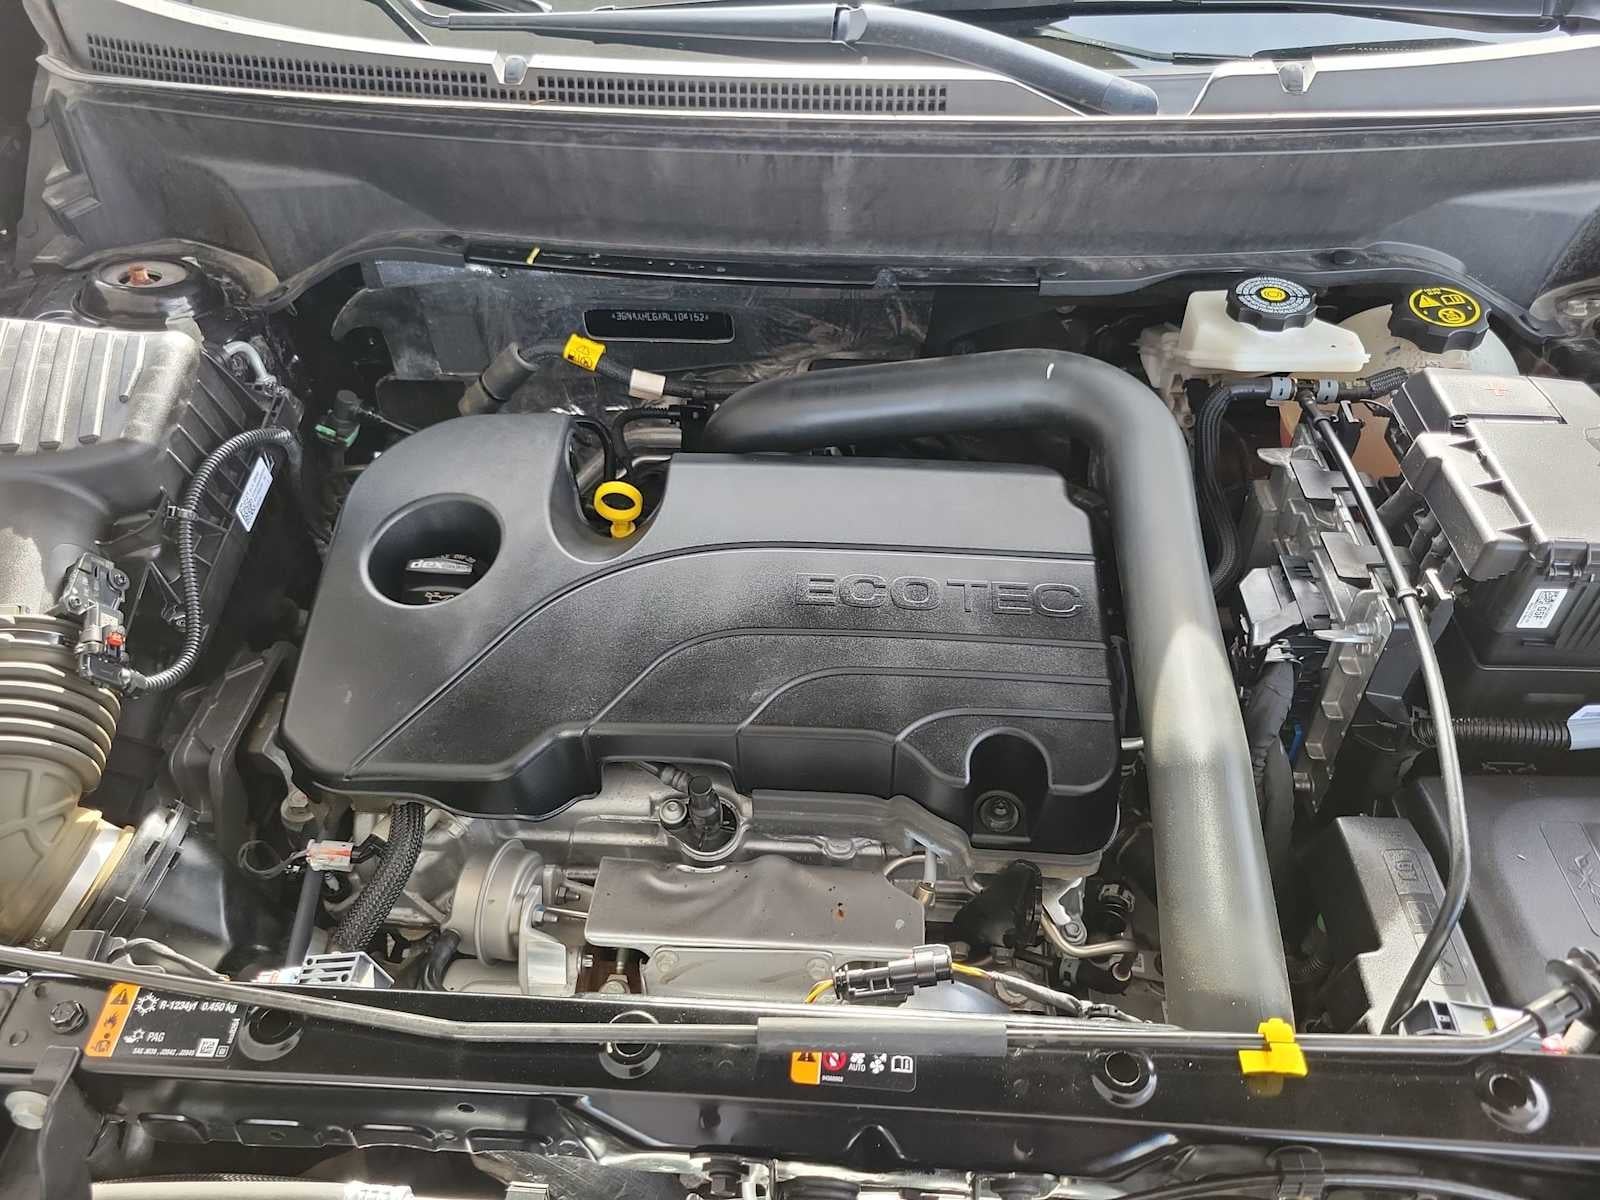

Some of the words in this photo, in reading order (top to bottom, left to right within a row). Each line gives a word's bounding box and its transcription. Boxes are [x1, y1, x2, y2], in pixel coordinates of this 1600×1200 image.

[796, 573, 1084, 618] ECOTEC
[200, 1001, 225, 1012] 0.450
[225, 1002, 238, 1014] kg
[147, 1031, 166, 1042] PAG
[848, 1063, 866, 1072] AUTO
